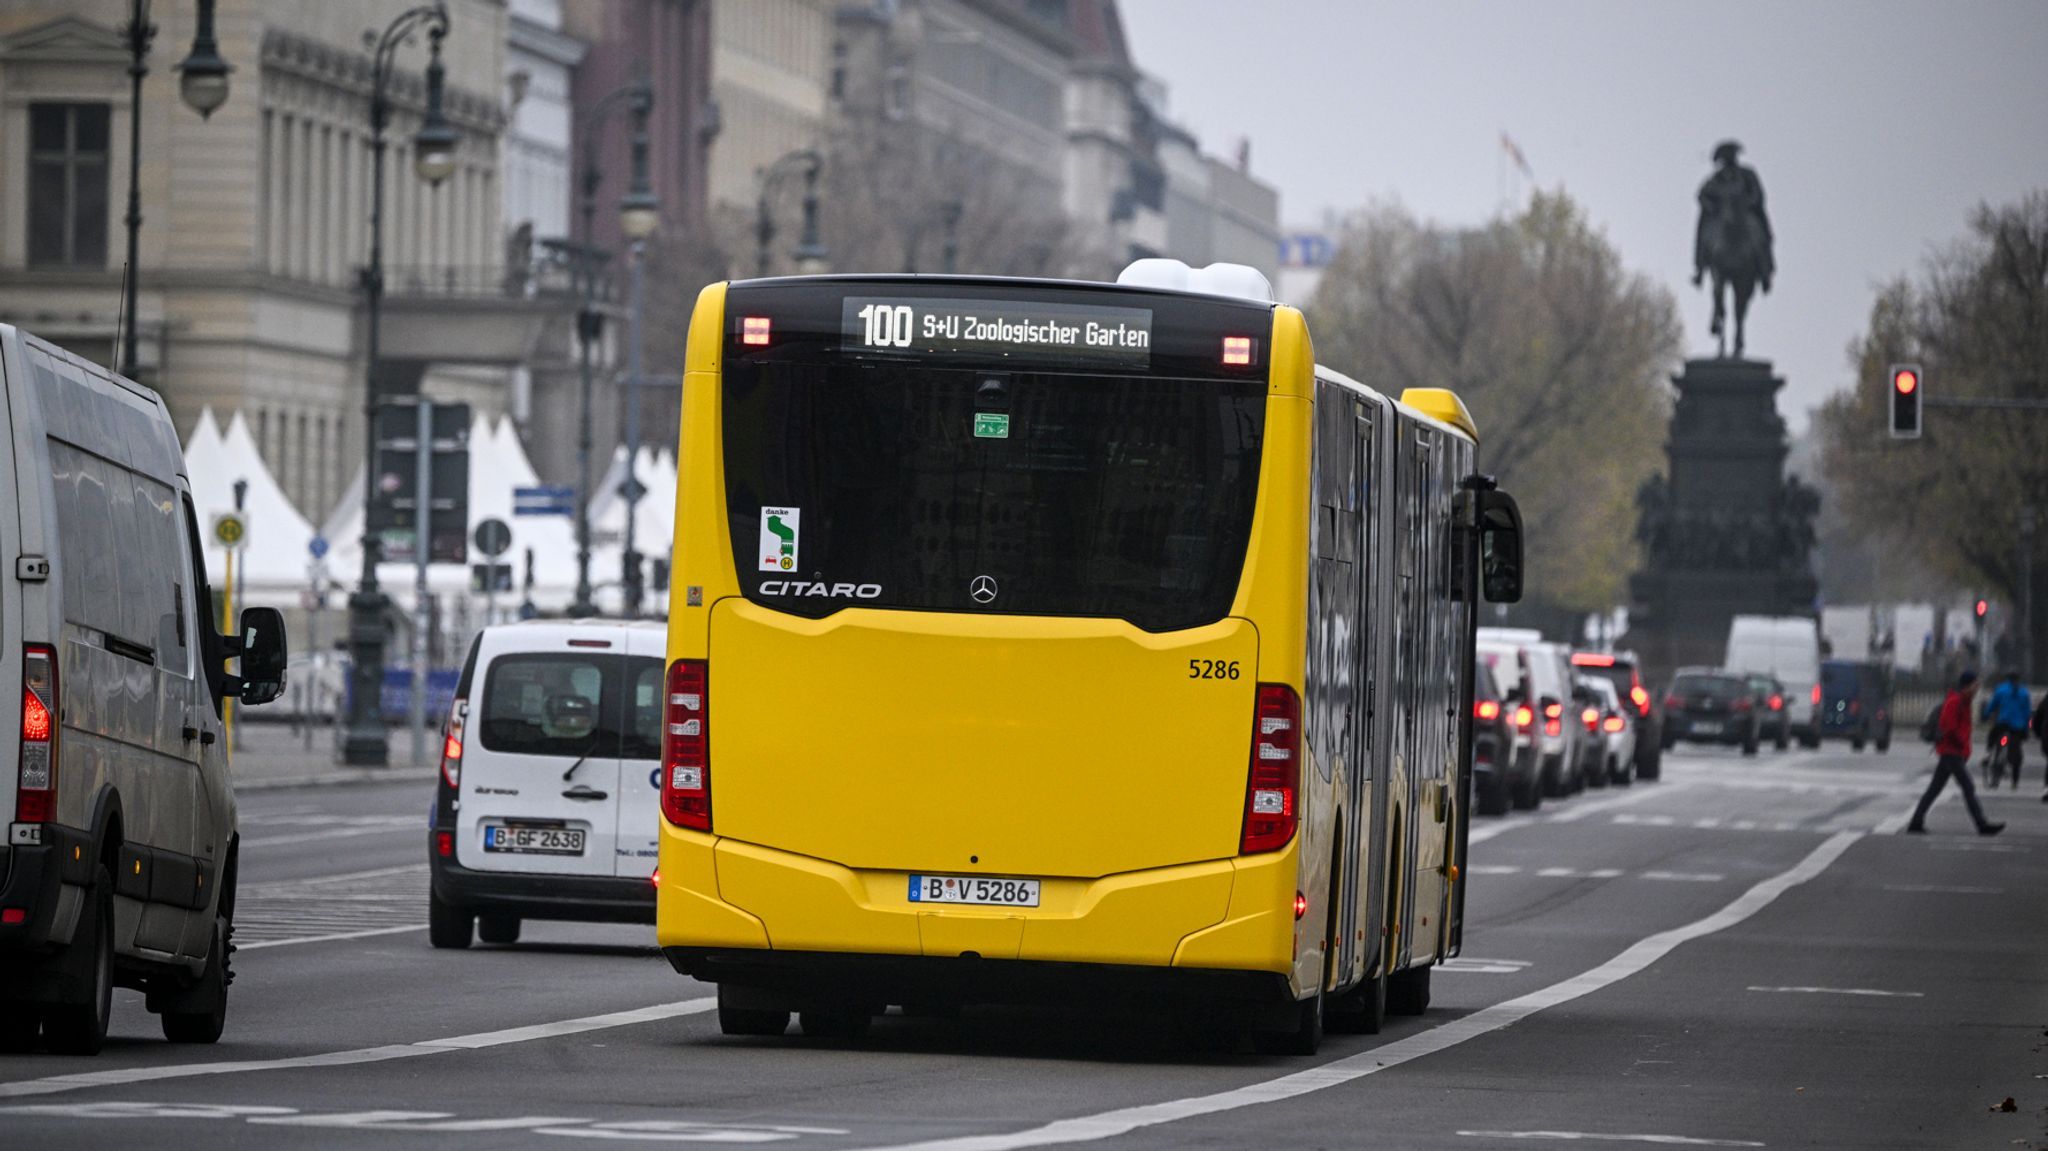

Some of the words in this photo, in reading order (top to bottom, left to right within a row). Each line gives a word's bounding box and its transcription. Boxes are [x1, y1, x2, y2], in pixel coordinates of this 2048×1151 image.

[858, 304, 914, 347] 100
[923, 314, 959, 339] S+U
[964, 316, 1080, 345] Zoologischer
[1085, 321, 1149, 348] Garten
[759, 581, 882, 598] CITARO
[1189, 659, 1240, 680] 5286
[495, 829, 506, 845] B
[516, 831, 536, 846] GF
[541, 832, 581, 849] 2638
[930, 878, 943, 899] B
[958, 879, 971, 900] V
[976, 880, 1029, 902] 5286
